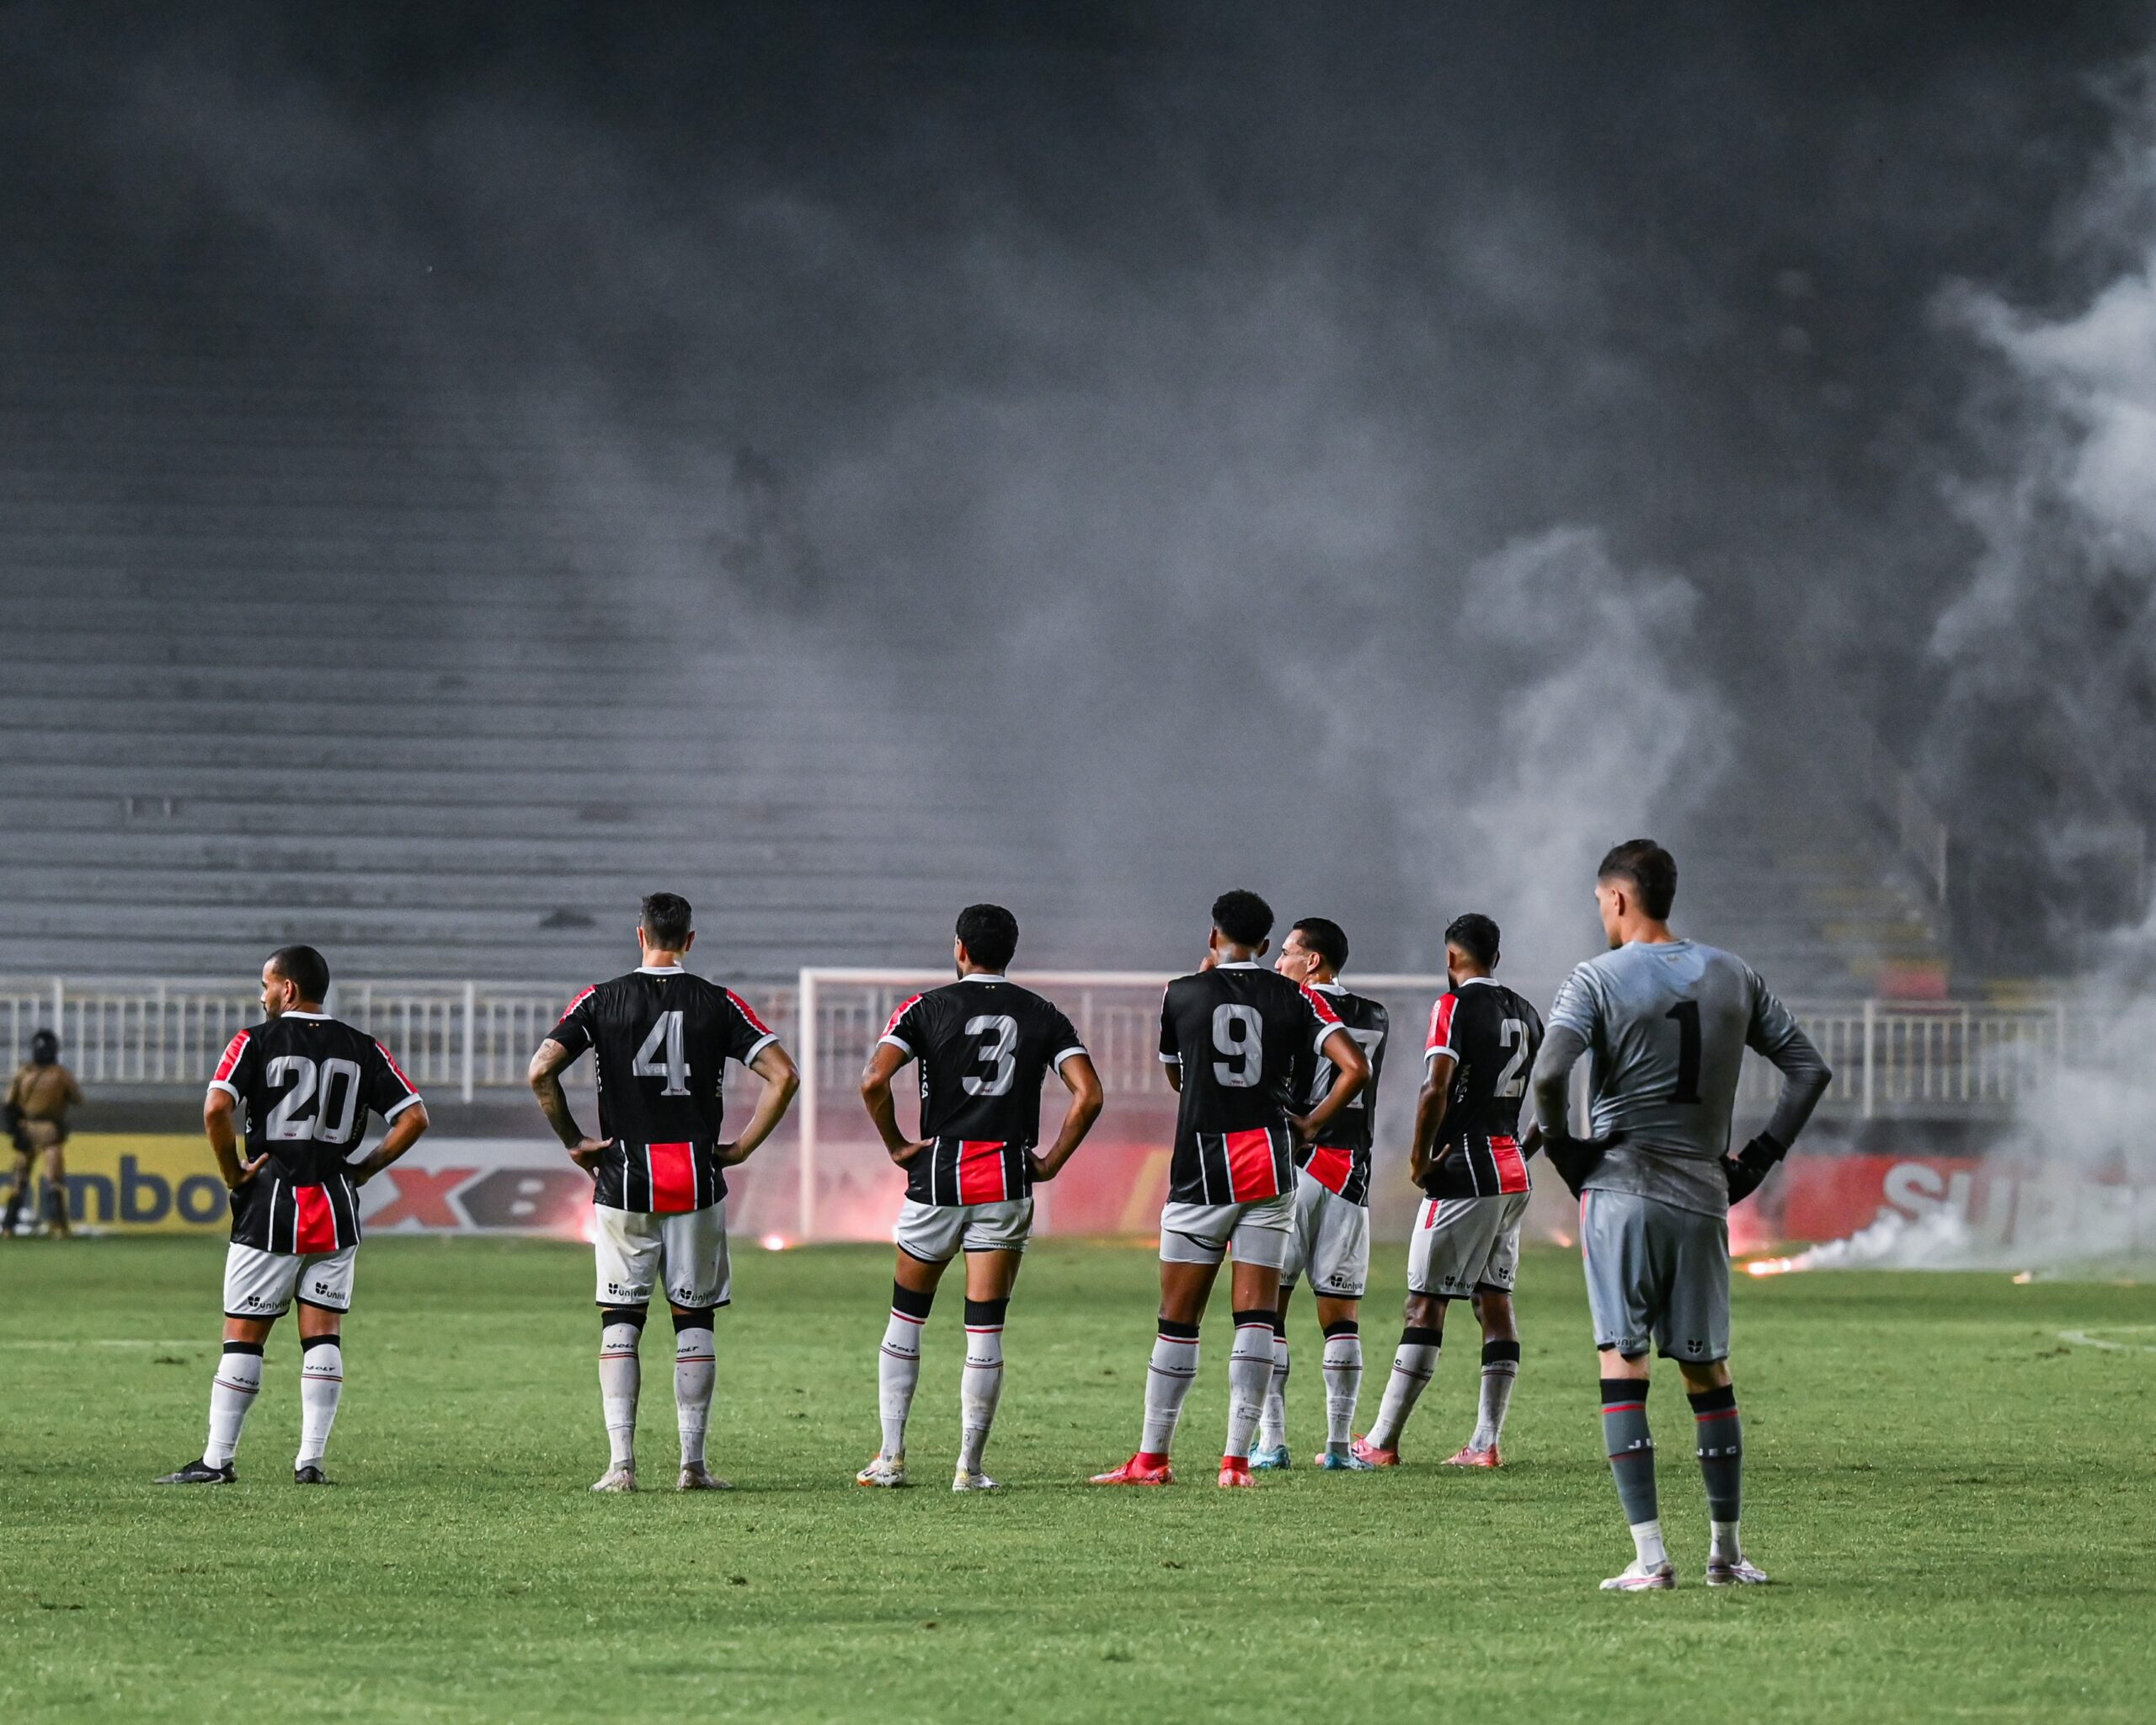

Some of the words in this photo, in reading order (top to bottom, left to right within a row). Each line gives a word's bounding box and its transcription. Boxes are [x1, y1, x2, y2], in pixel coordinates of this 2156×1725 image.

[632, 1010, 691, 1096] 4
[962, 1014, 1018, 1096] 3
[1213, 1003, 1262, 1088] 9
[1493, 1018, 1530, 1097] 2
[1665, 1001, 1702, 1105] 1
[266, 1055, 361, 1144] 20
[0, 1154, 228, 1225] mbo
[363, 1167, 595, 1229] XB
